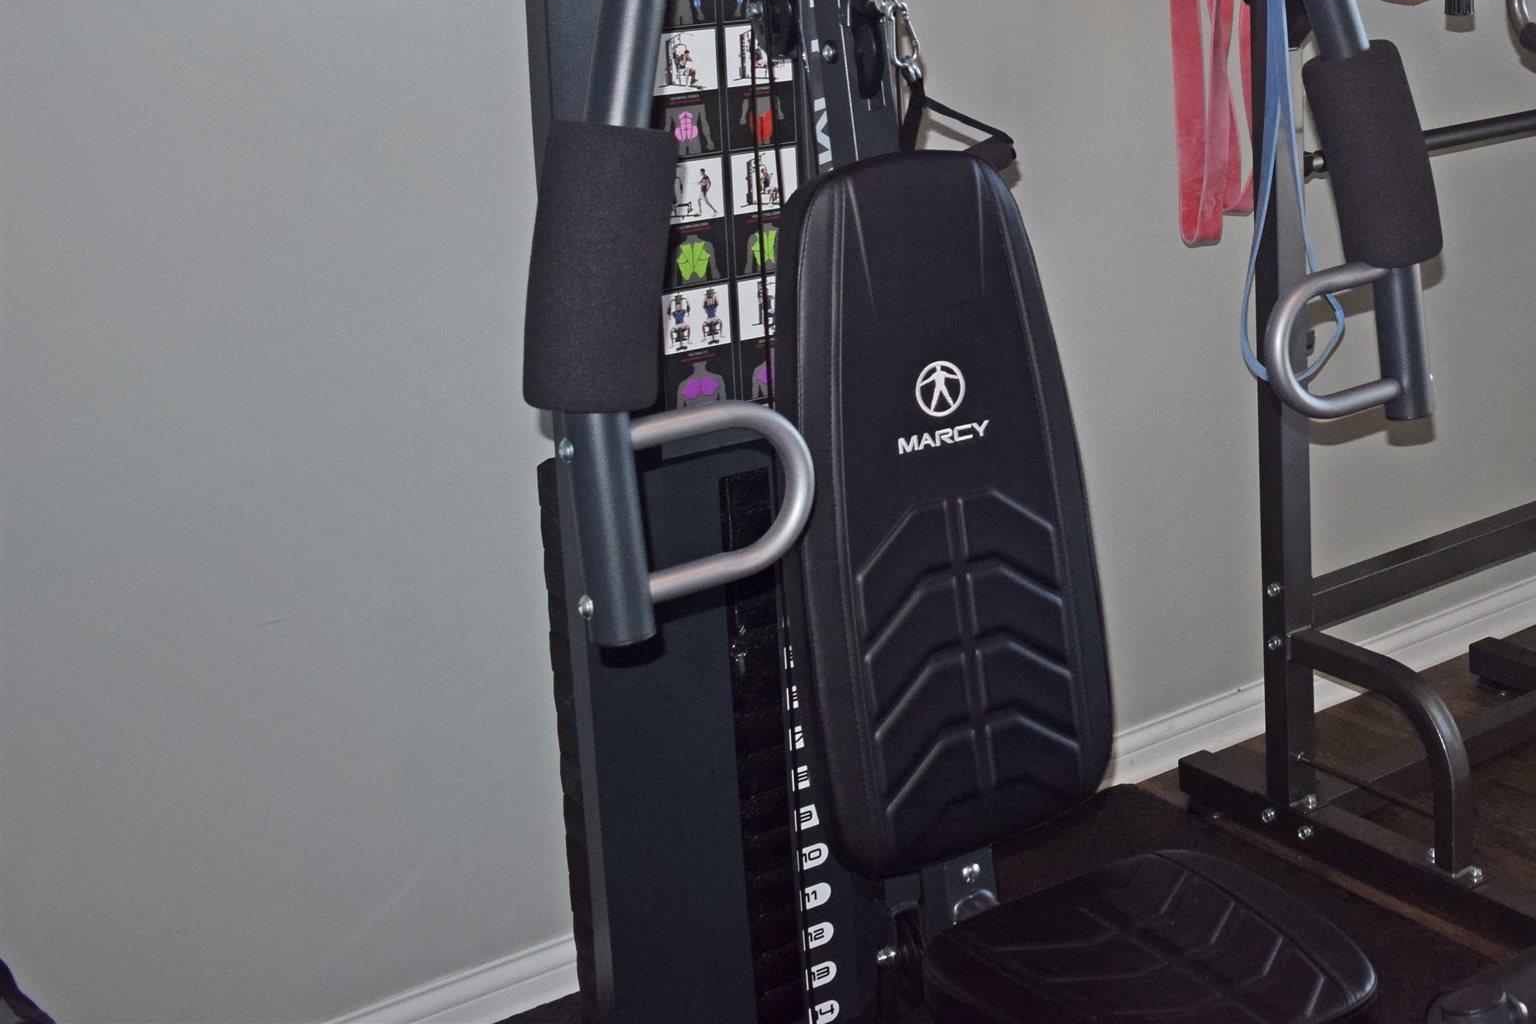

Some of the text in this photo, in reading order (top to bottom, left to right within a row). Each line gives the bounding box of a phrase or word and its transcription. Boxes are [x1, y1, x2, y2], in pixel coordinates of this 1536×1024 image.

[898, 420, 989, 454] MARCY
[808, 927, 825, 942] 12
[812, 966, 830, 982] 13
